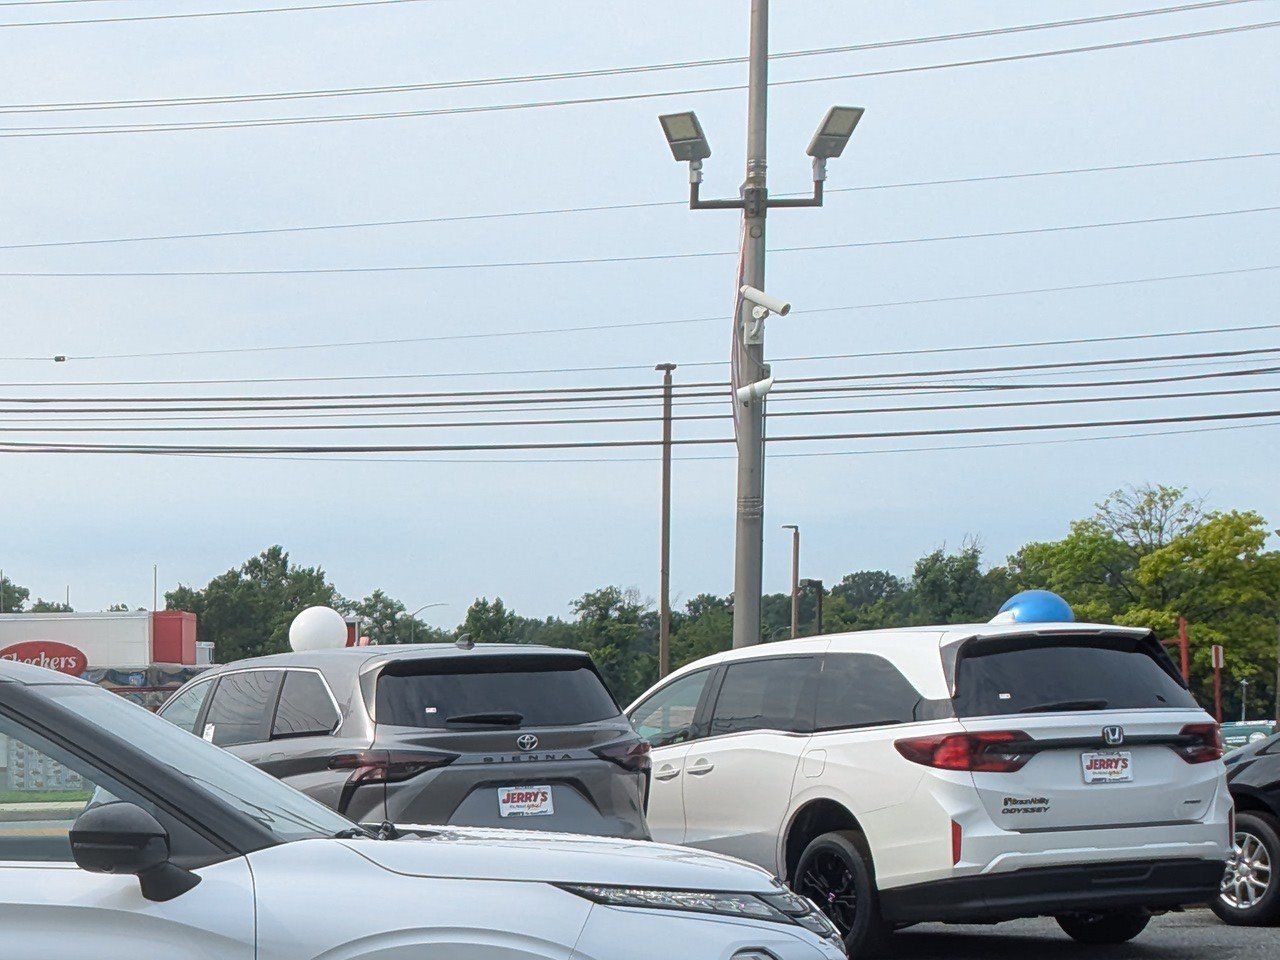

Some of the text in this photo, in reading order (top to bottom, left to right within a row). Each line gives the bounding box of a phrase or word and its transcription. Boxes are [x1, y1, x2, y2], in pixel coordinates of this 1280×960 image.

[483, 753, 572, 763] SIENNA
[1086, 757, 1129, 770] JERRY'S
[502, 791, 549, 804] JERRY'S
[1001, 806, 1051, 814] ODYSSEY
